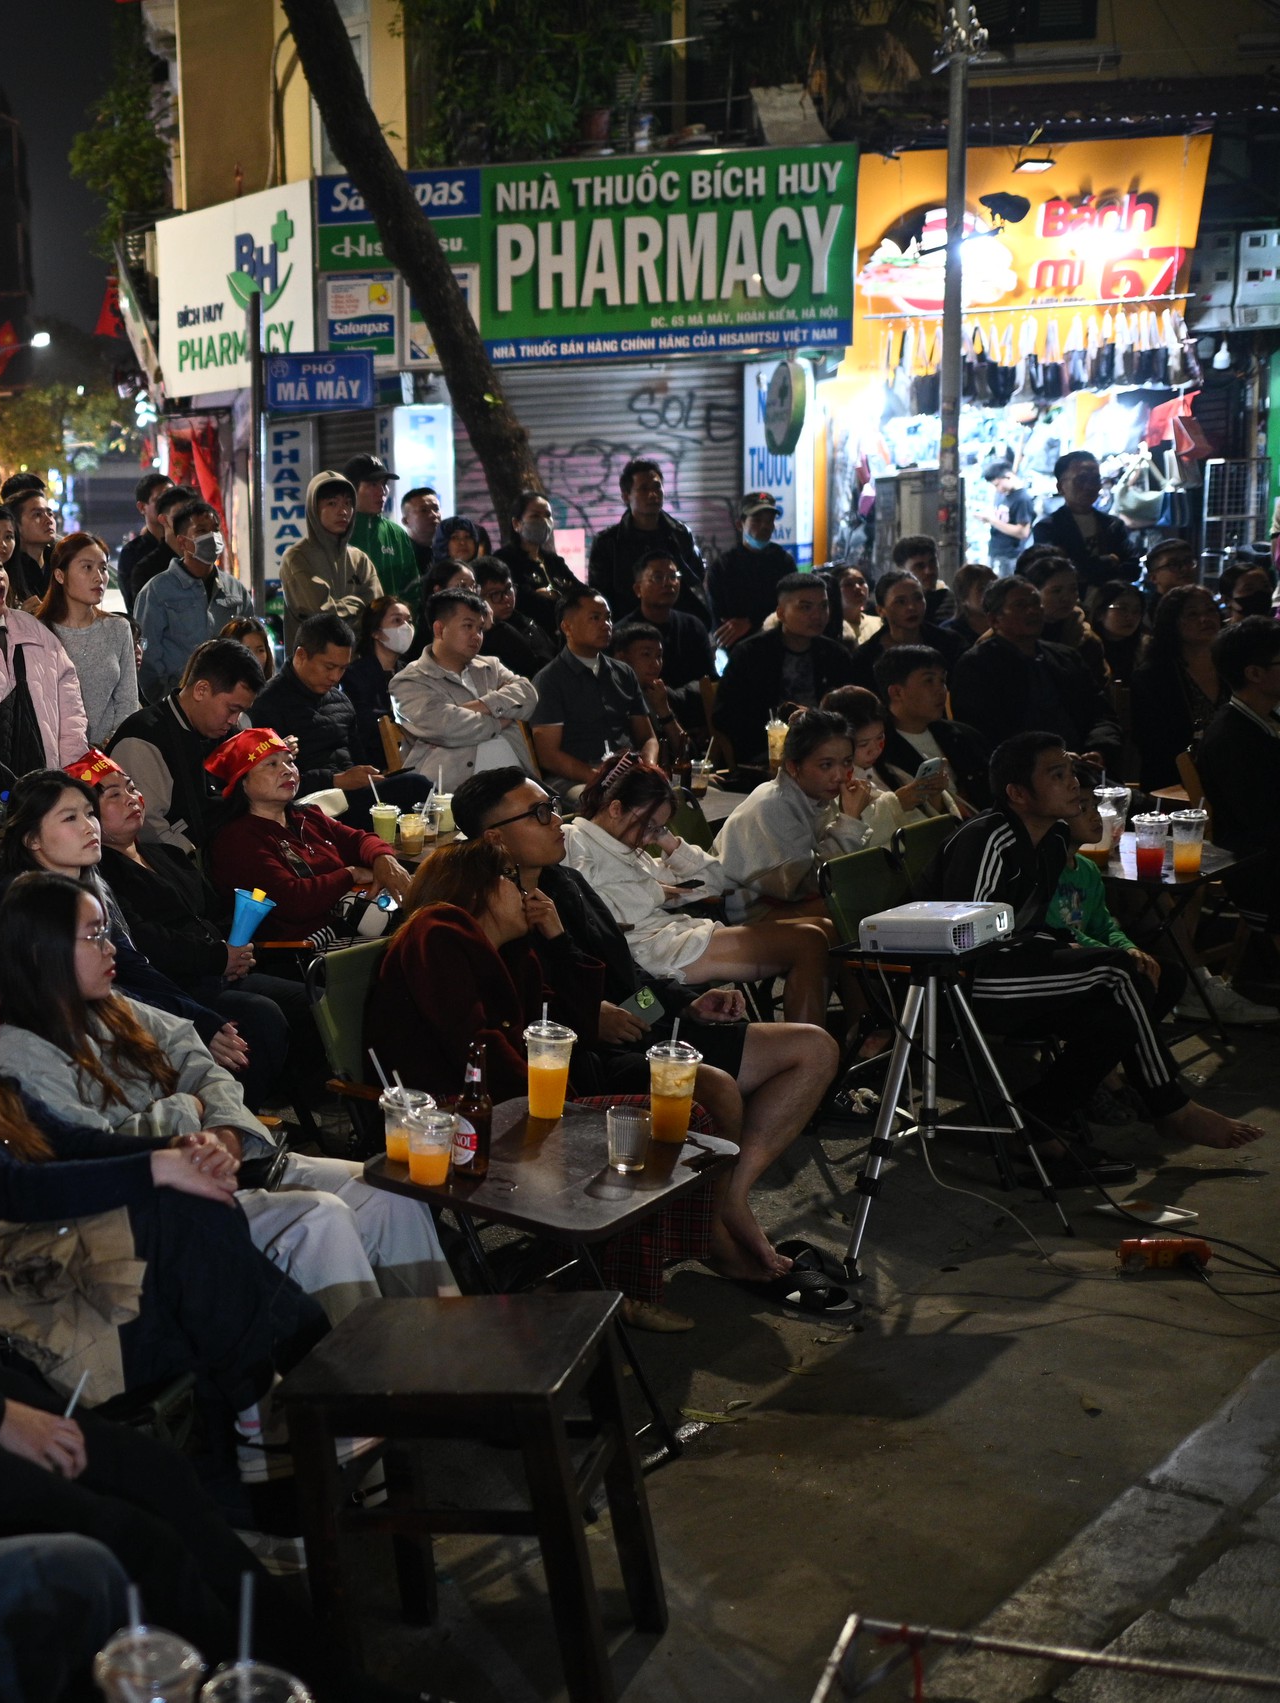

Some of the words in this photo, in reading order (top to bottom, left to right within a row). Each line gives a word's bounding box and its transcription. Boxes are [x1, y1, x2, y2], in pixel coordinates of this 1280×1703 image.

[330, 180, 466, 213] Sapas
[496, 172, 561, 213] NHÀ
[572, 160, 680, 208] THUỐC
[691, 160, 766, 200] BÍCH
[778, 161, 843, 195] HUY
[497, 204, 844, 312] PHARMACY
[1100, 246, 1186, 300] 67
[177, 304, 200, 329] BÍCH
[202, 302, 224, 323] HUY
[333, 321, 390, 337] Salonpas
[178, 320, 294, 373] PHARMCY
[493, 343, 516, 359] NHÀ
[519, 339, 557, 357] THUỐC
[560, 338, 584, 355] BÁN
[587, 337, 618, 354] HÀNG
[621, 335, 656, 352] CHÍNH
[692, 330, 716, 347] CỦA
[719, 331, 780, 346] HISAMITSU
[783, 327, 809, 344] VIỆT
[812, 327, 838, 341] NAM
[301, 359, 337, 375] PHỐ
[276, 377, 310, 401] MÃ
[316, 376, 361, 400] MÂY
[271, 430, 306, 566] PHARMAC
[256, 740, 271, 754] TÔI
